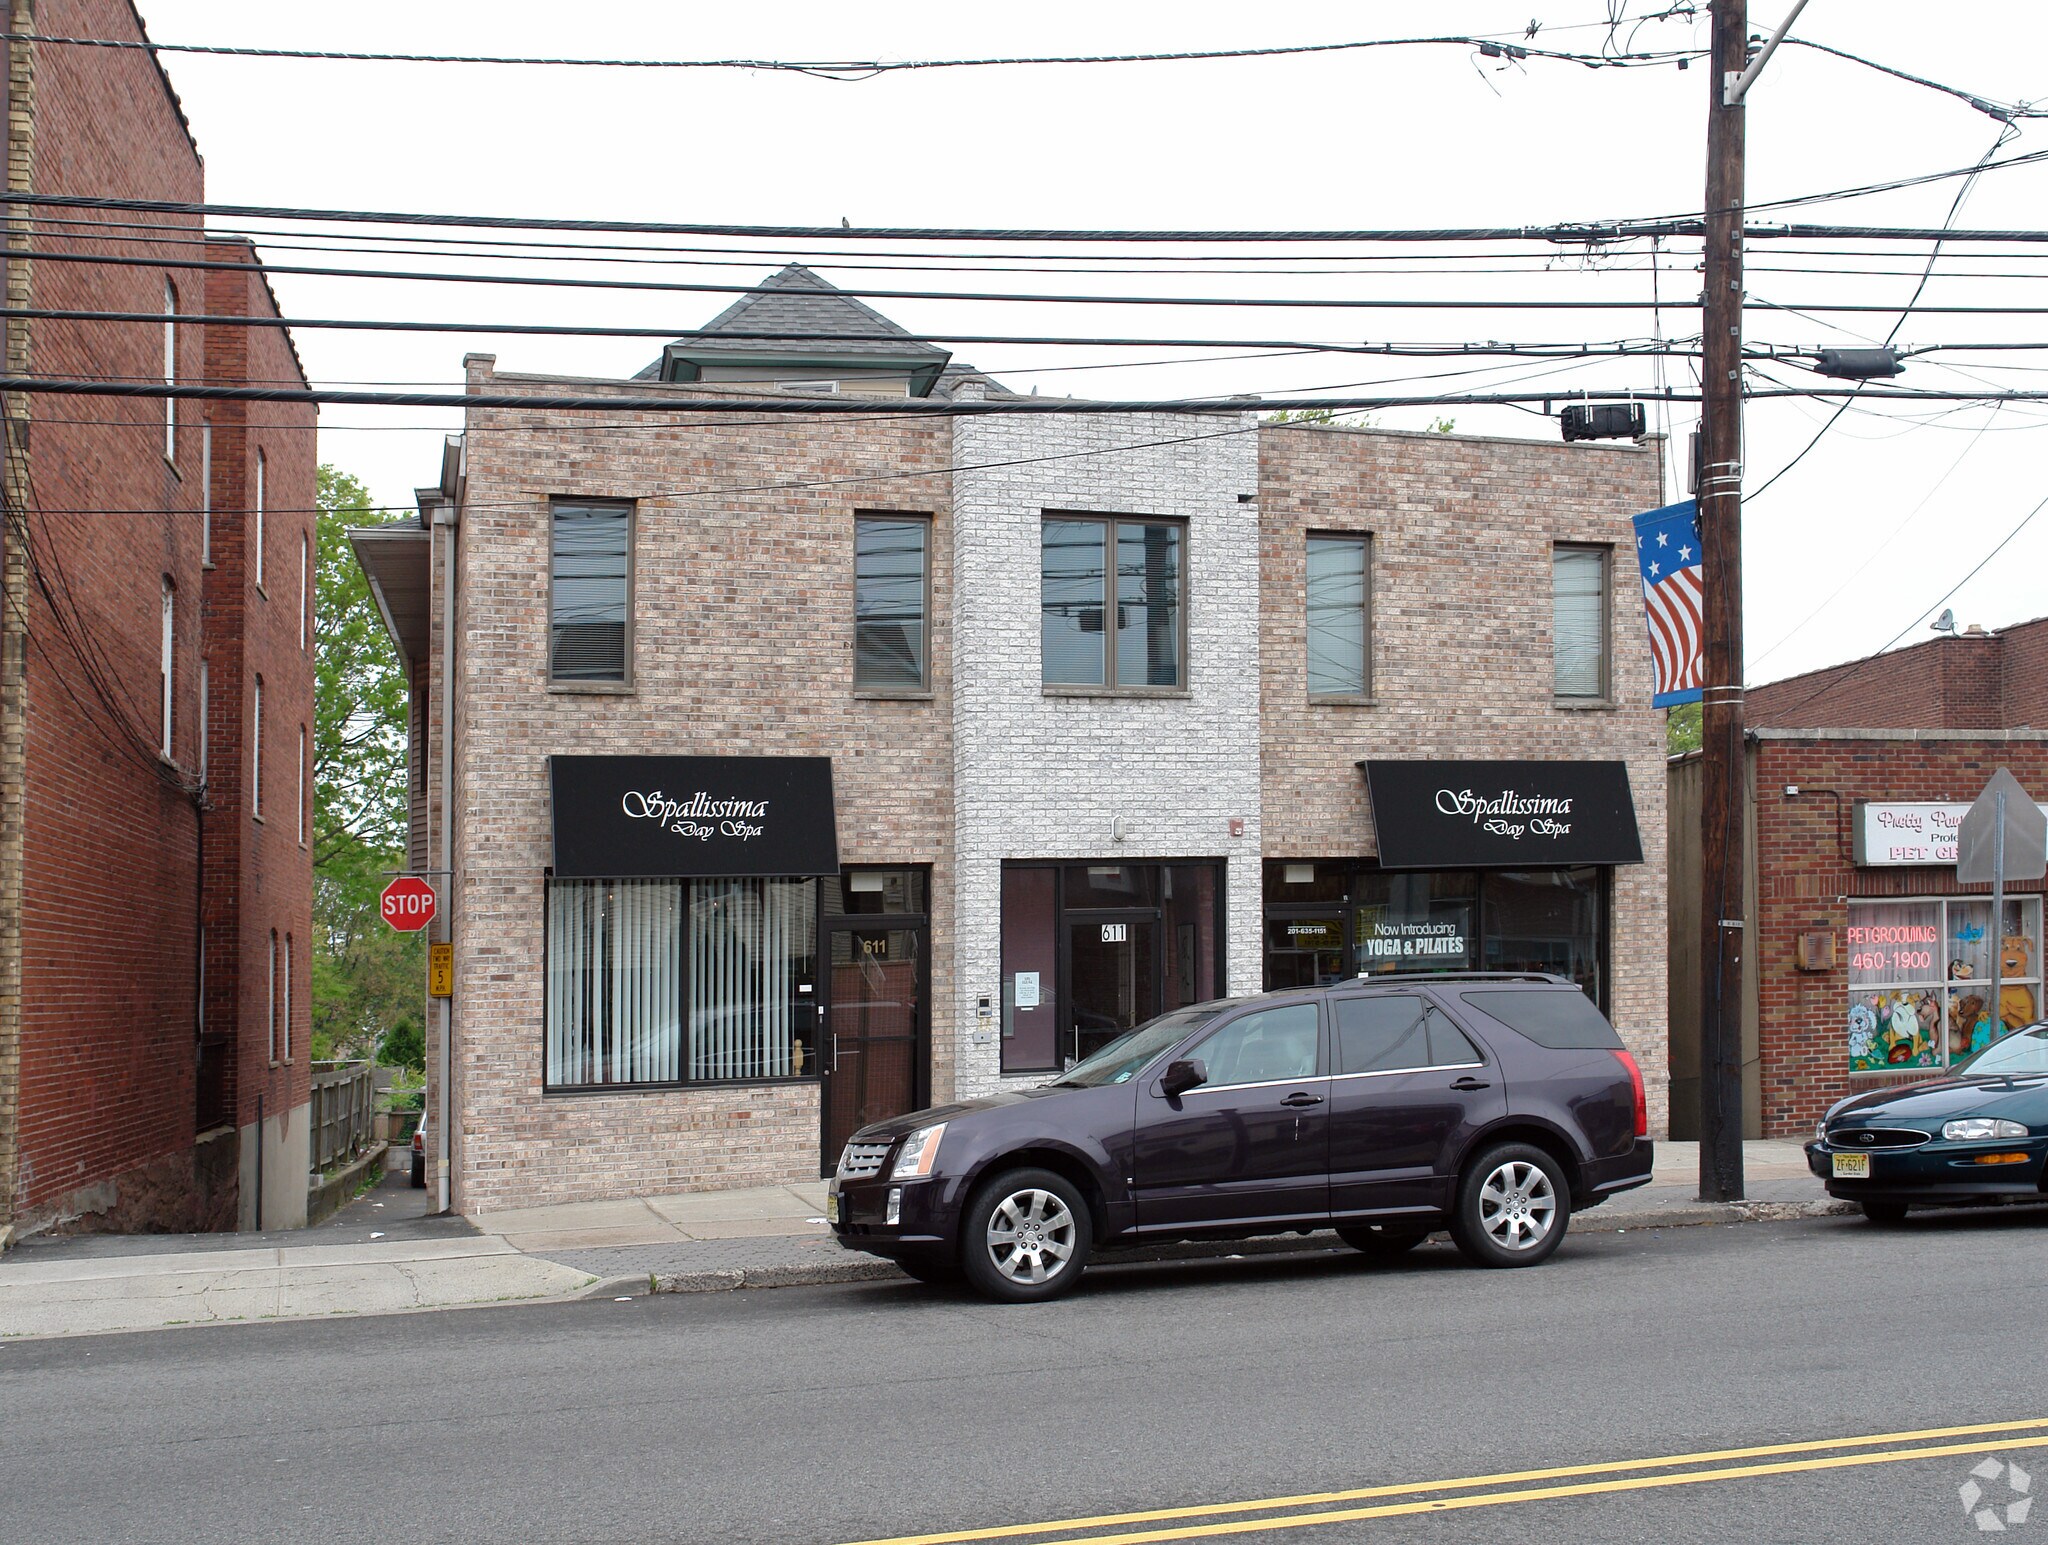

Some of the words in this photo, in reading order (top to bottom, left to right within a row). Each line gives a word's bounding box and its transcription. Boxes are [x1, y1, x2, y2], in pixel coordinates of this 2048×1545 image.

[622, 790, 770, 827] Spallissima
[1435, 789, 1573, 824] Spallissima
[670, 820, 715, 841] Day
[720, 820, 764, 841] Spa
[1483, 818, 1525, 840] Day
[1529, 818, 1572, 839] Spa
[1889, 847, 1928, 860] PET
[384, 894, 433, 915] STOP
[1102, 925, 1125, 941] 611
[1374, 923, 1400, 936] Now
[1400, 921, 1456, 936] Introducing
[863, 940, 886, 954] 611
[1366, 938, 1402, 956] YOGA
[1403, 940, 1414, 955] &
[1415, 936, 1464, 955] PILATES
[1852, 951, 1931, 970] 460-1900
[438, 970, 444, 984] 5
